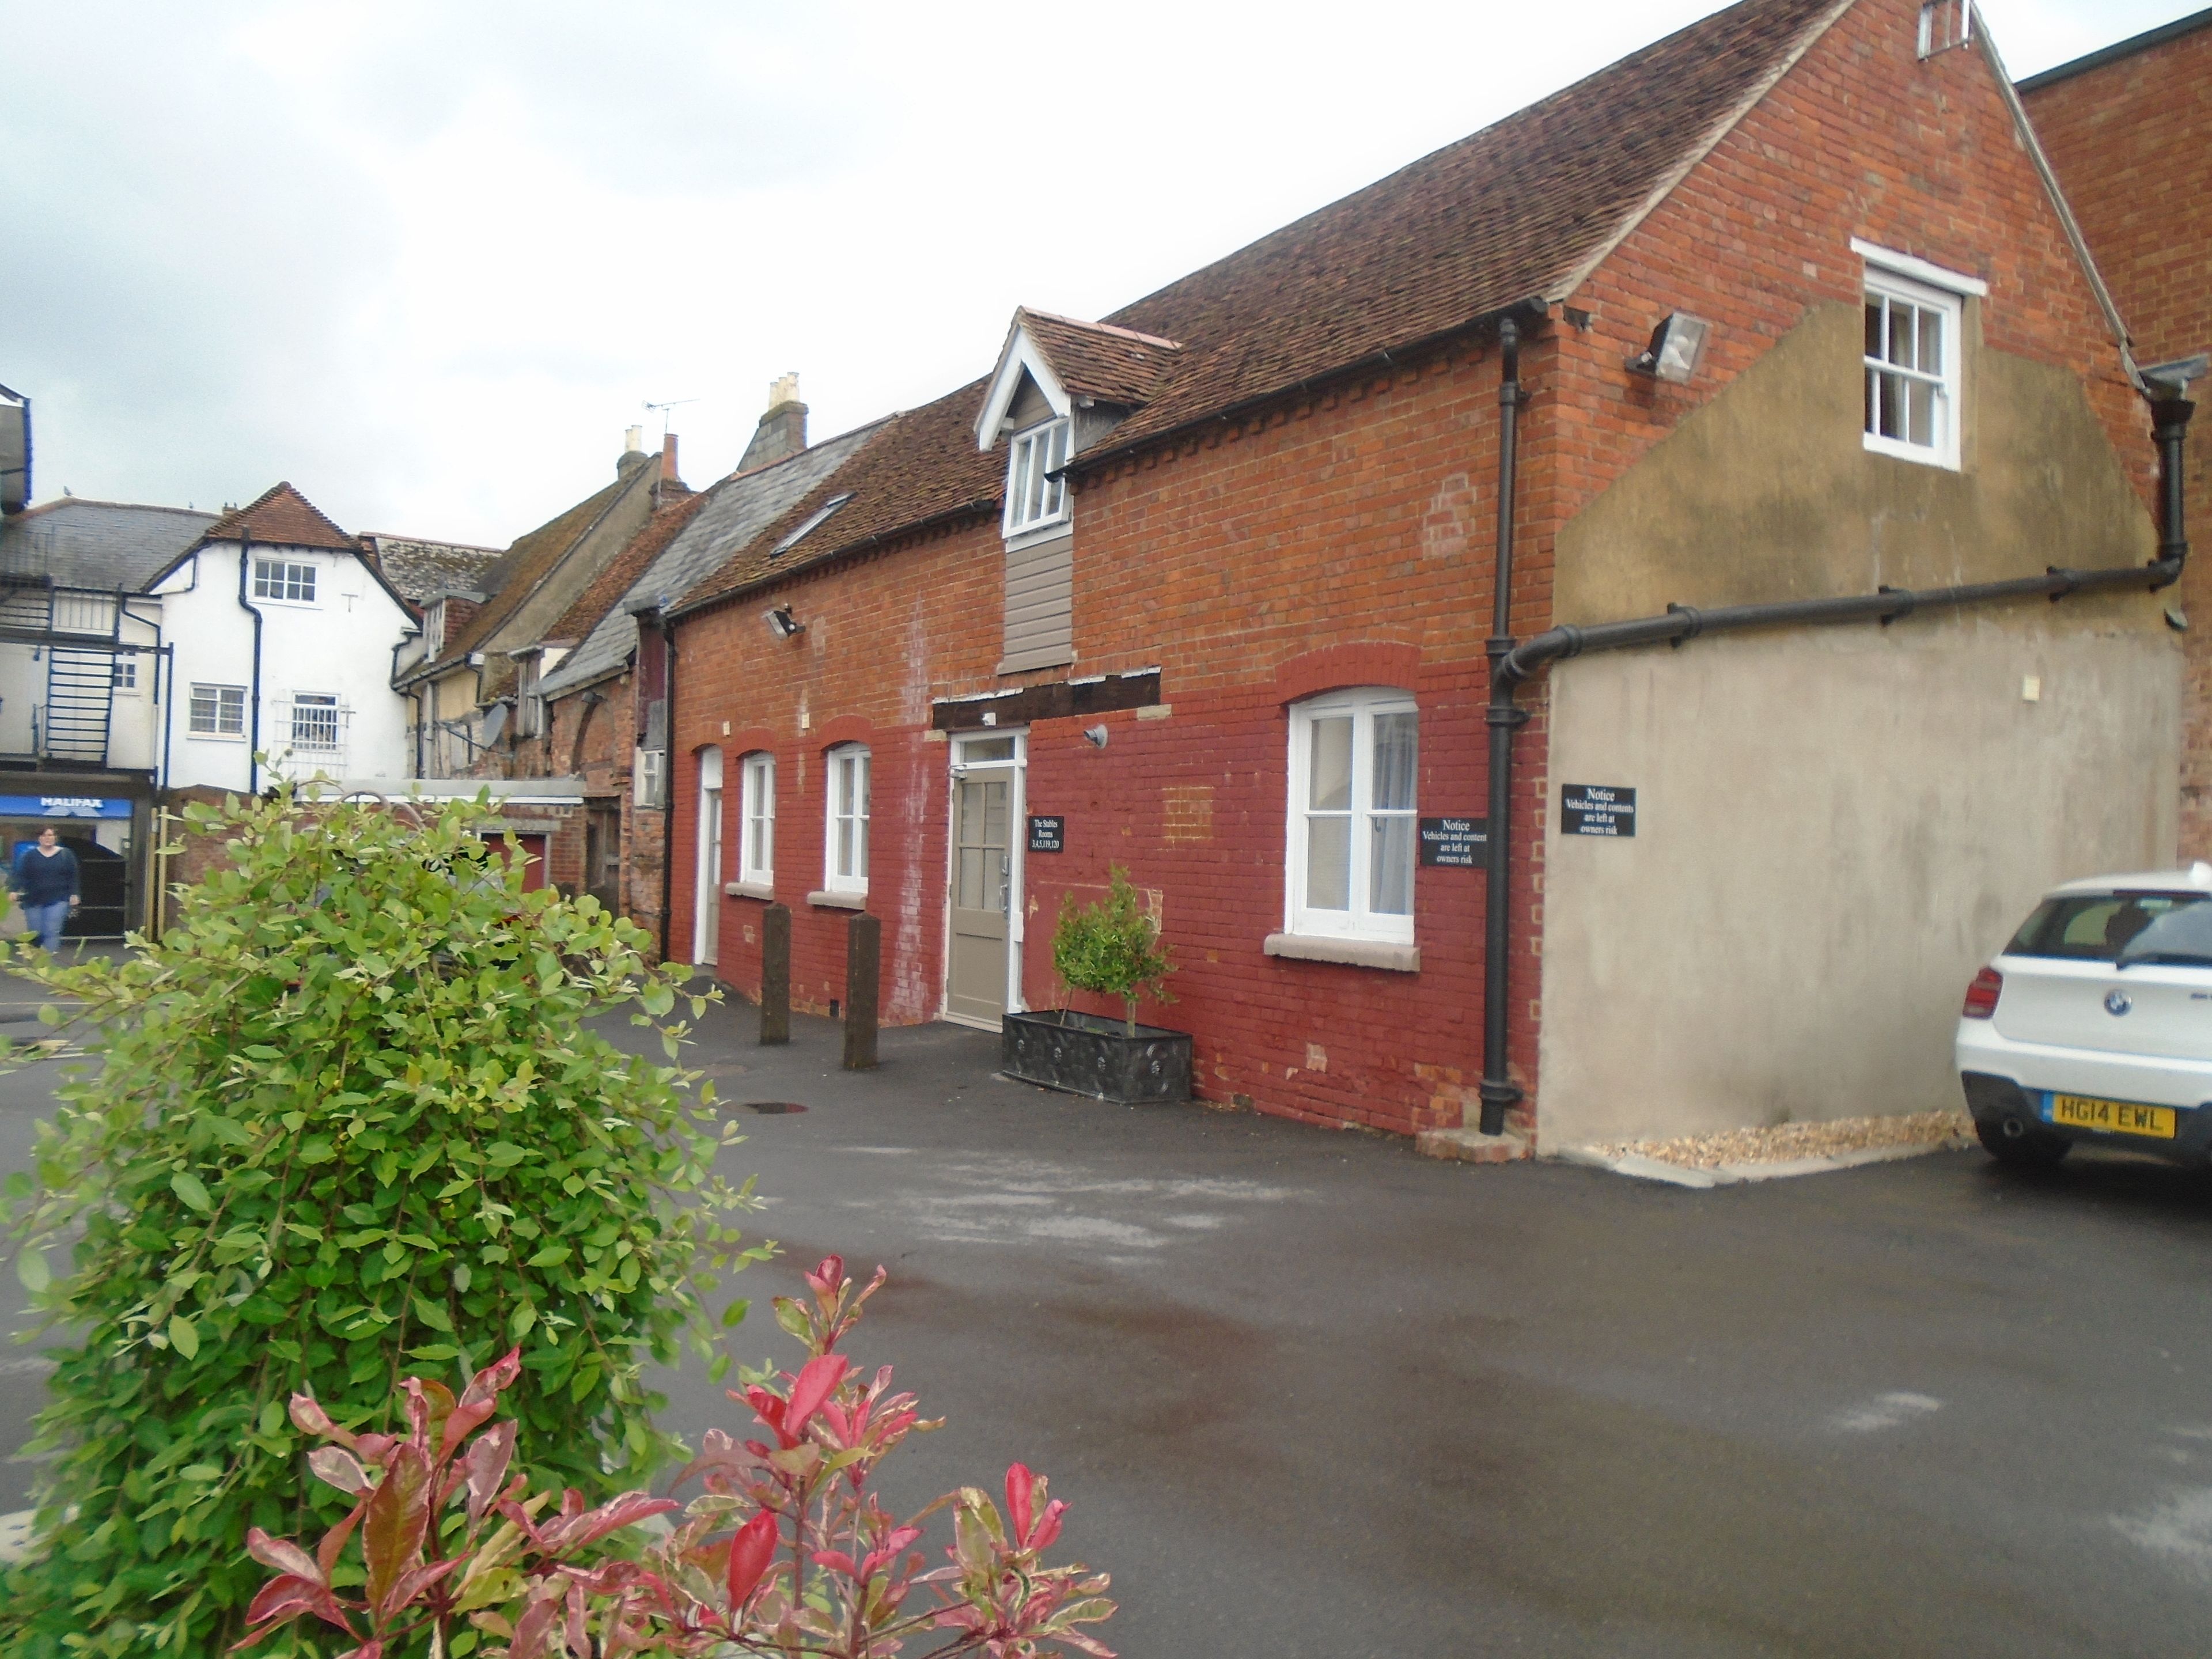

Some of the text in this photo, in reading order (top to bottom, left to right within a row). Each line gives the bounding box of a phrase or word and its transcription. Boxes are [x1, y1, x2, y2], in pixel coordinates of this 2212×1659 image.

[1587, 788, 1615, 801] Notice
[40, 797, 104, 808] HALIFAX
[1566, 798, 1634, 813] Vehicles and contents
[1585, 813, 1615, 823] are left at
[1043, 819, 1058, 828] Stables
[1443, 820, 1470, 831] Notice
[1039, 830, 1053, 838] Rooms
[1580, 825, 1618, 835] owners risk
[1423, 831, 1449, 840] Vehicles
[1450, 832, 1462, 841] and
[1452, 843, 1463, 852] left
[1464, 844, 1470, 852] at
[1437, 855, 1473, 864] owners risk
[2062, 1097, 2164, 1132] HG14 EWL
